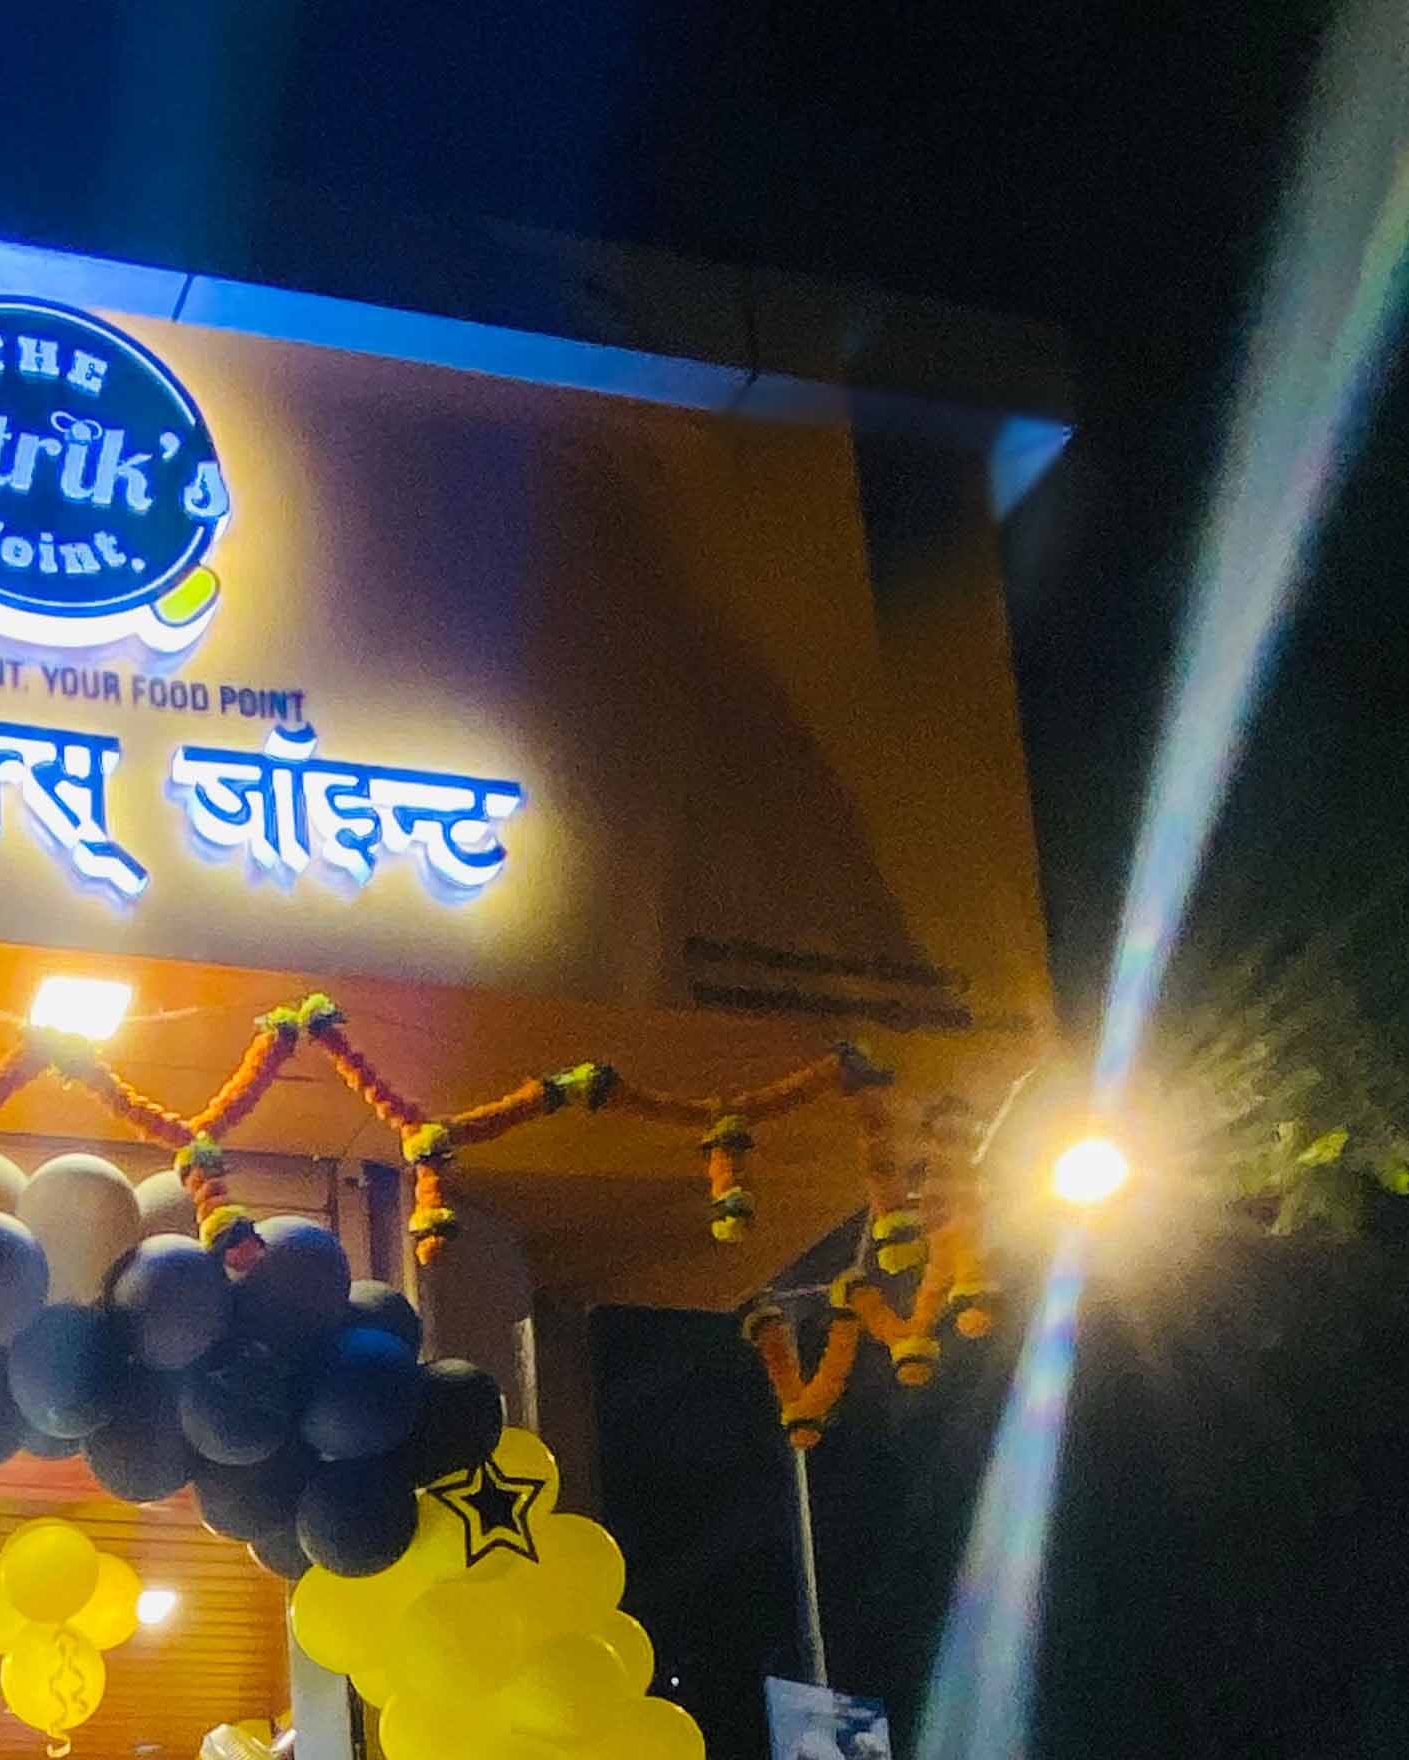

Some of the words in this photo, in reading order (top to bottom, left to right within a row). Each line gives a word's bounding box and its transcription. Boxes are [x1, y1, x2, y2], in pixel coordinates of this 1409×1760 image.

[41, 665, 121, 705] YOUR
[131, 674, 210, 713] FOOD
[219, 684, 306, 722] POINT
